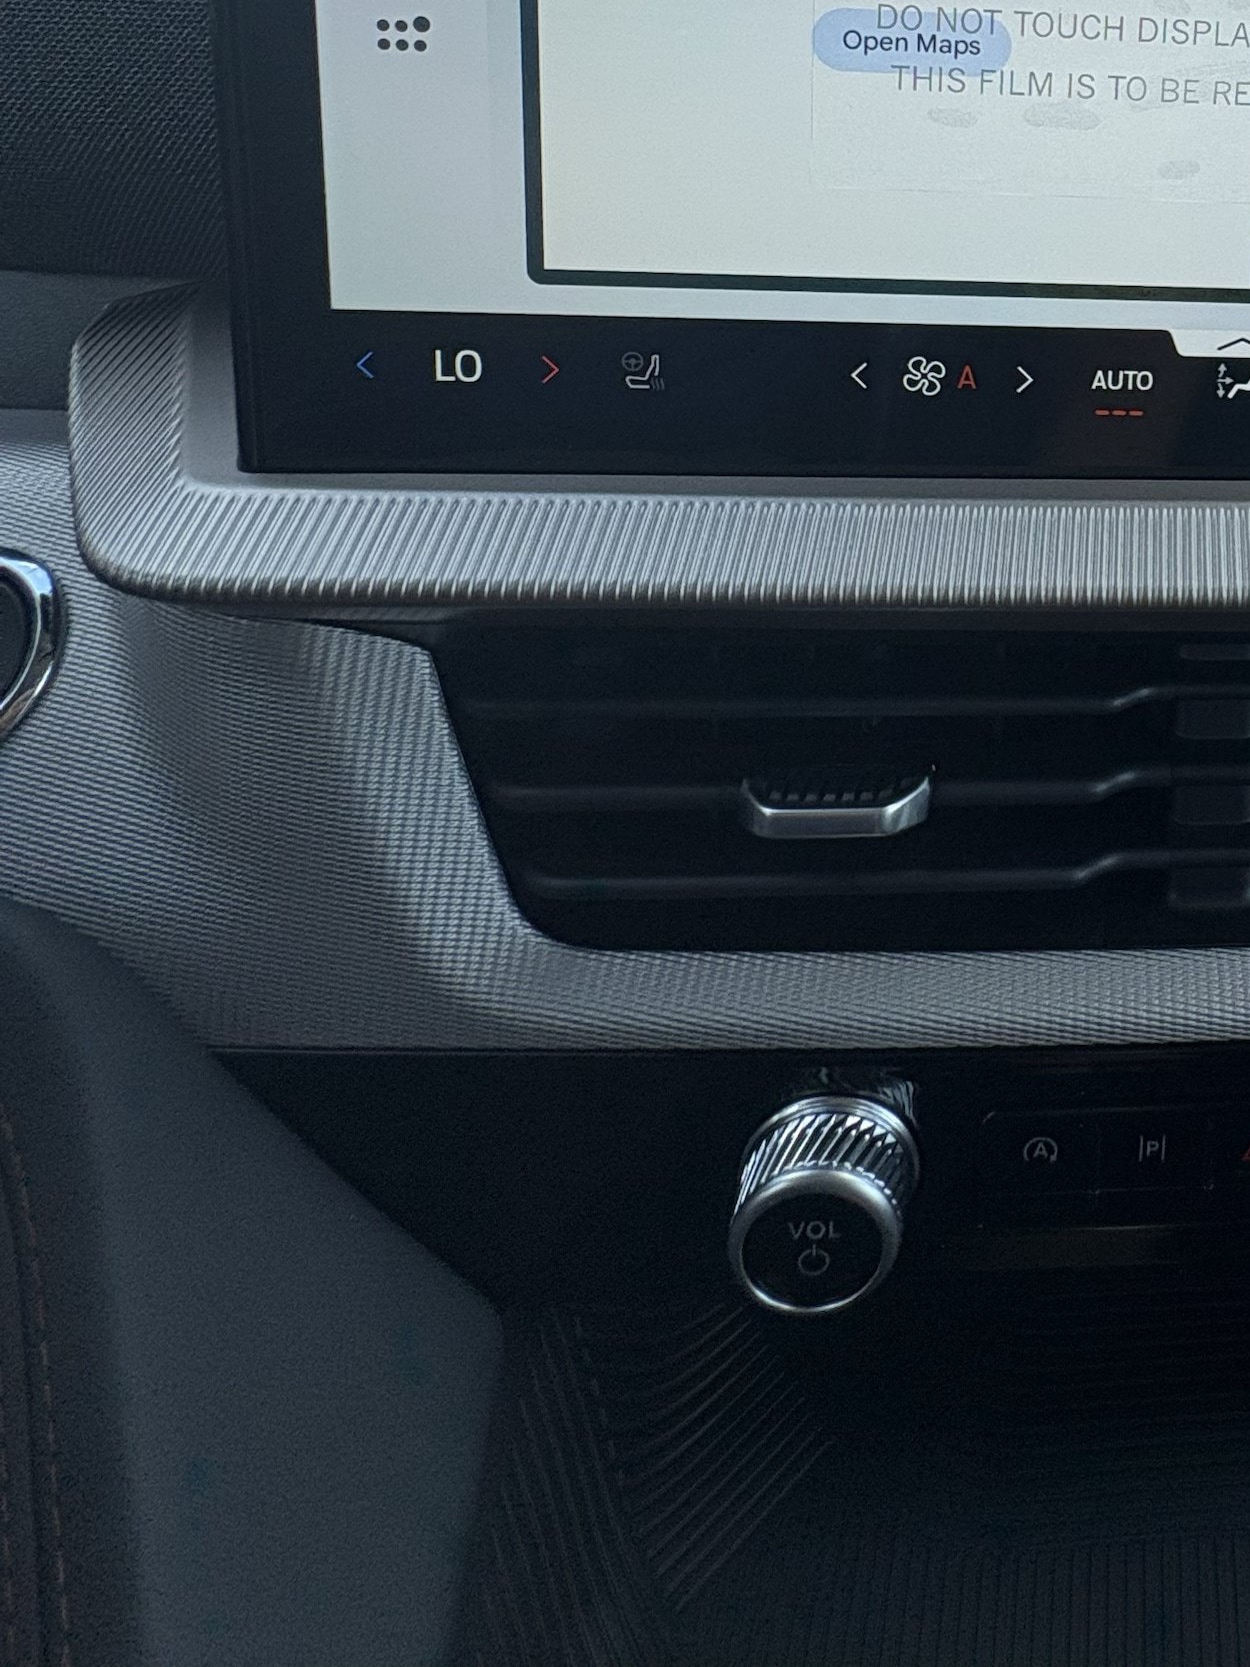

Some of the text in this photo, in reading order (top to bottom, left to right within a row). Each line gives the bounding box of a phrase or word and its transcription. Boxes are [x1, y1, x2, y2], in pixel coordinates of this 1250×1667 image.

[876, 3, 923, 32] DO
[936, 6, 1003, 35] NOT
[1013, 10, 1125, 42] TOUCH
[843, 30, 981, 60] Open Maps
[890, 64, 967, 93] THIS
[979, 68, 1053, 97] FILM
[1067, 73, 1096, 100] IS
[1107, 74, 1148, 102] TO
[1160, 77, 1201, 105] BE
[434, 349, 483, 383] LO
[1091, 369, 1154, 391] AUTO
[789, 1220, 841, 1239] VOL
